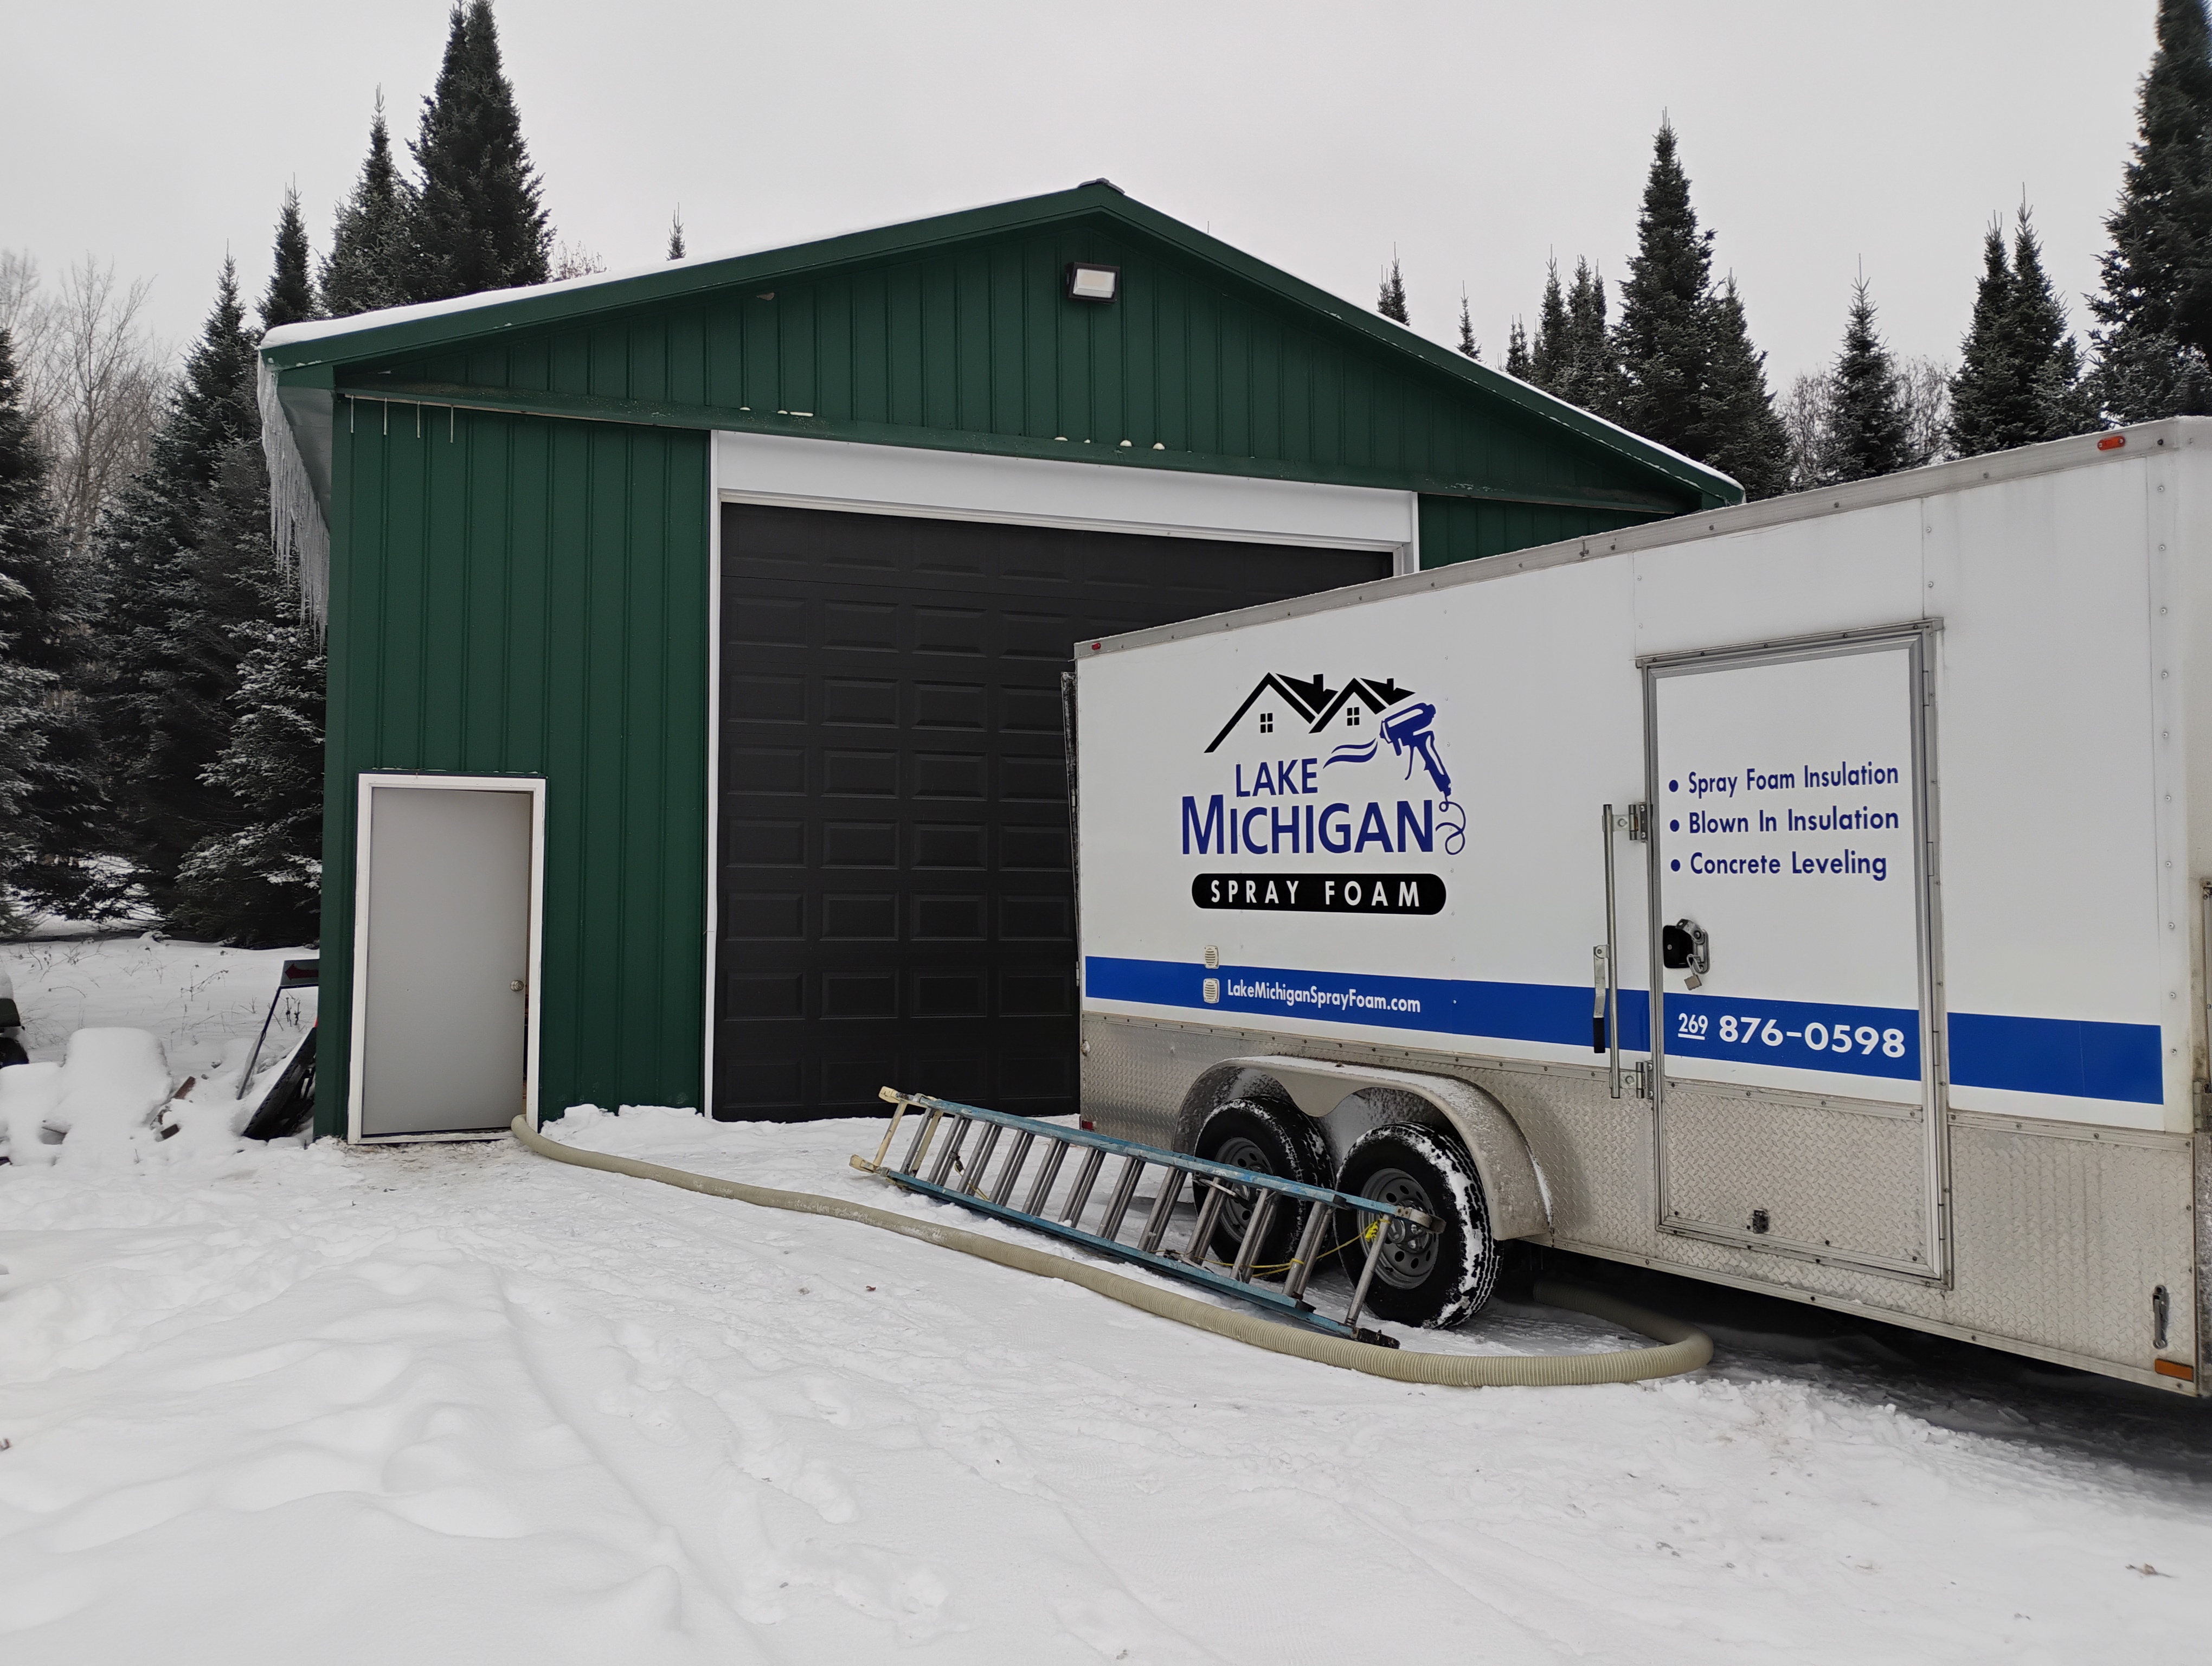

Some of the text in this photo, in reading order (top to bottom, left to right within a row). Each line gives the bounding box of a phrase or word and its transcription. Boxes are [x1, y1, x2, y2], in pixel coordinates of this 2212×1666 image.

[1236, 758, 1317, 797] LAKE
[1689, 761, 1898, 799] Spray Foam Insulation
[1182, 794, 1433, 854] MICHIGAN
[1689, 806, 1899, 833] Blown In Insulation
[1691, 849, 1886, 881] Concrete Leveling
[1212, 880, 1419, 906] SPRAY FOAM
[1227, 979, 1421, 1013] LakeMichiganSprayFoam.com
[1679, 1013, 1905, 1058] 269 876-0598
